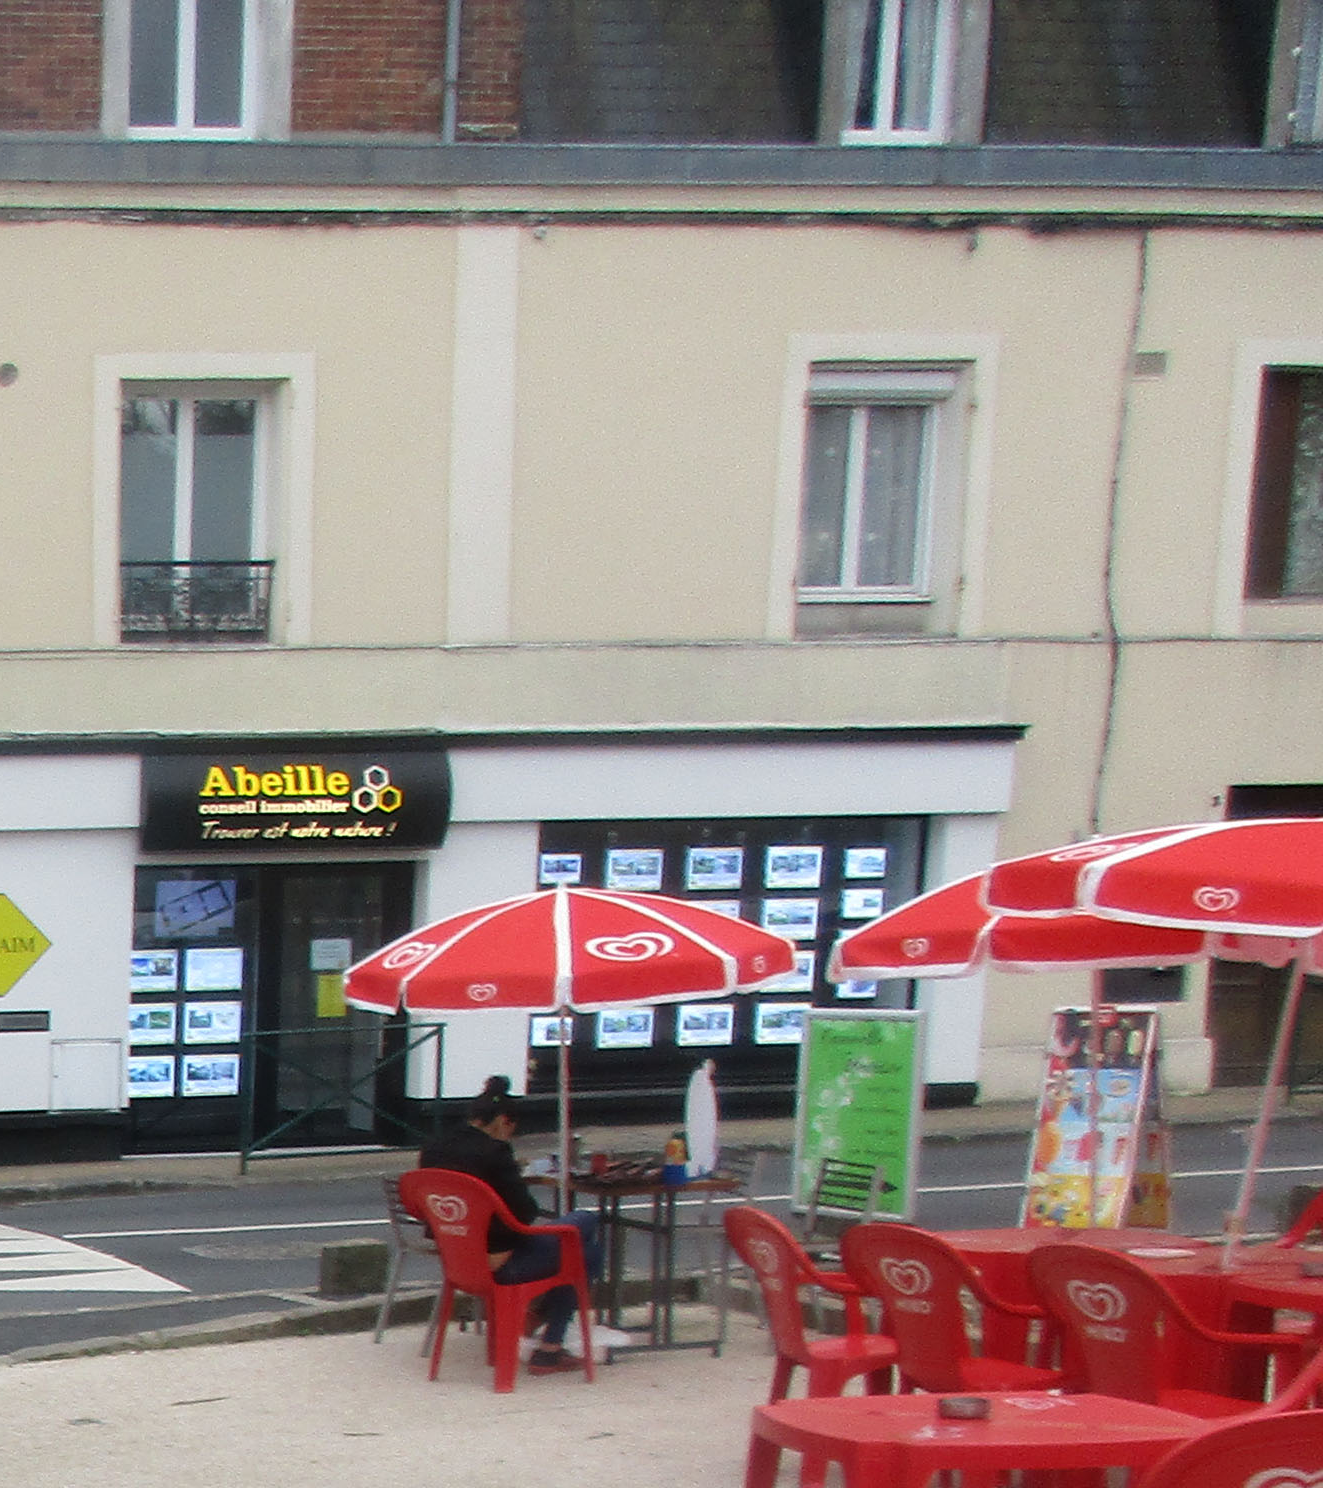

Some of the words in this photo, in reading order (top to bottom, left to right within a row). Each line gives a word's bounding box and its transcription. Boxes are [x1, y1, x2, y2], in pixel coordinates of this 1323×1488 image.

[199, 765, 350, 797] Abeille
[198, 800, 257, 815] conseil
[259, 799, 350, 814] immobilier
[262, 821, 290, 839] est
